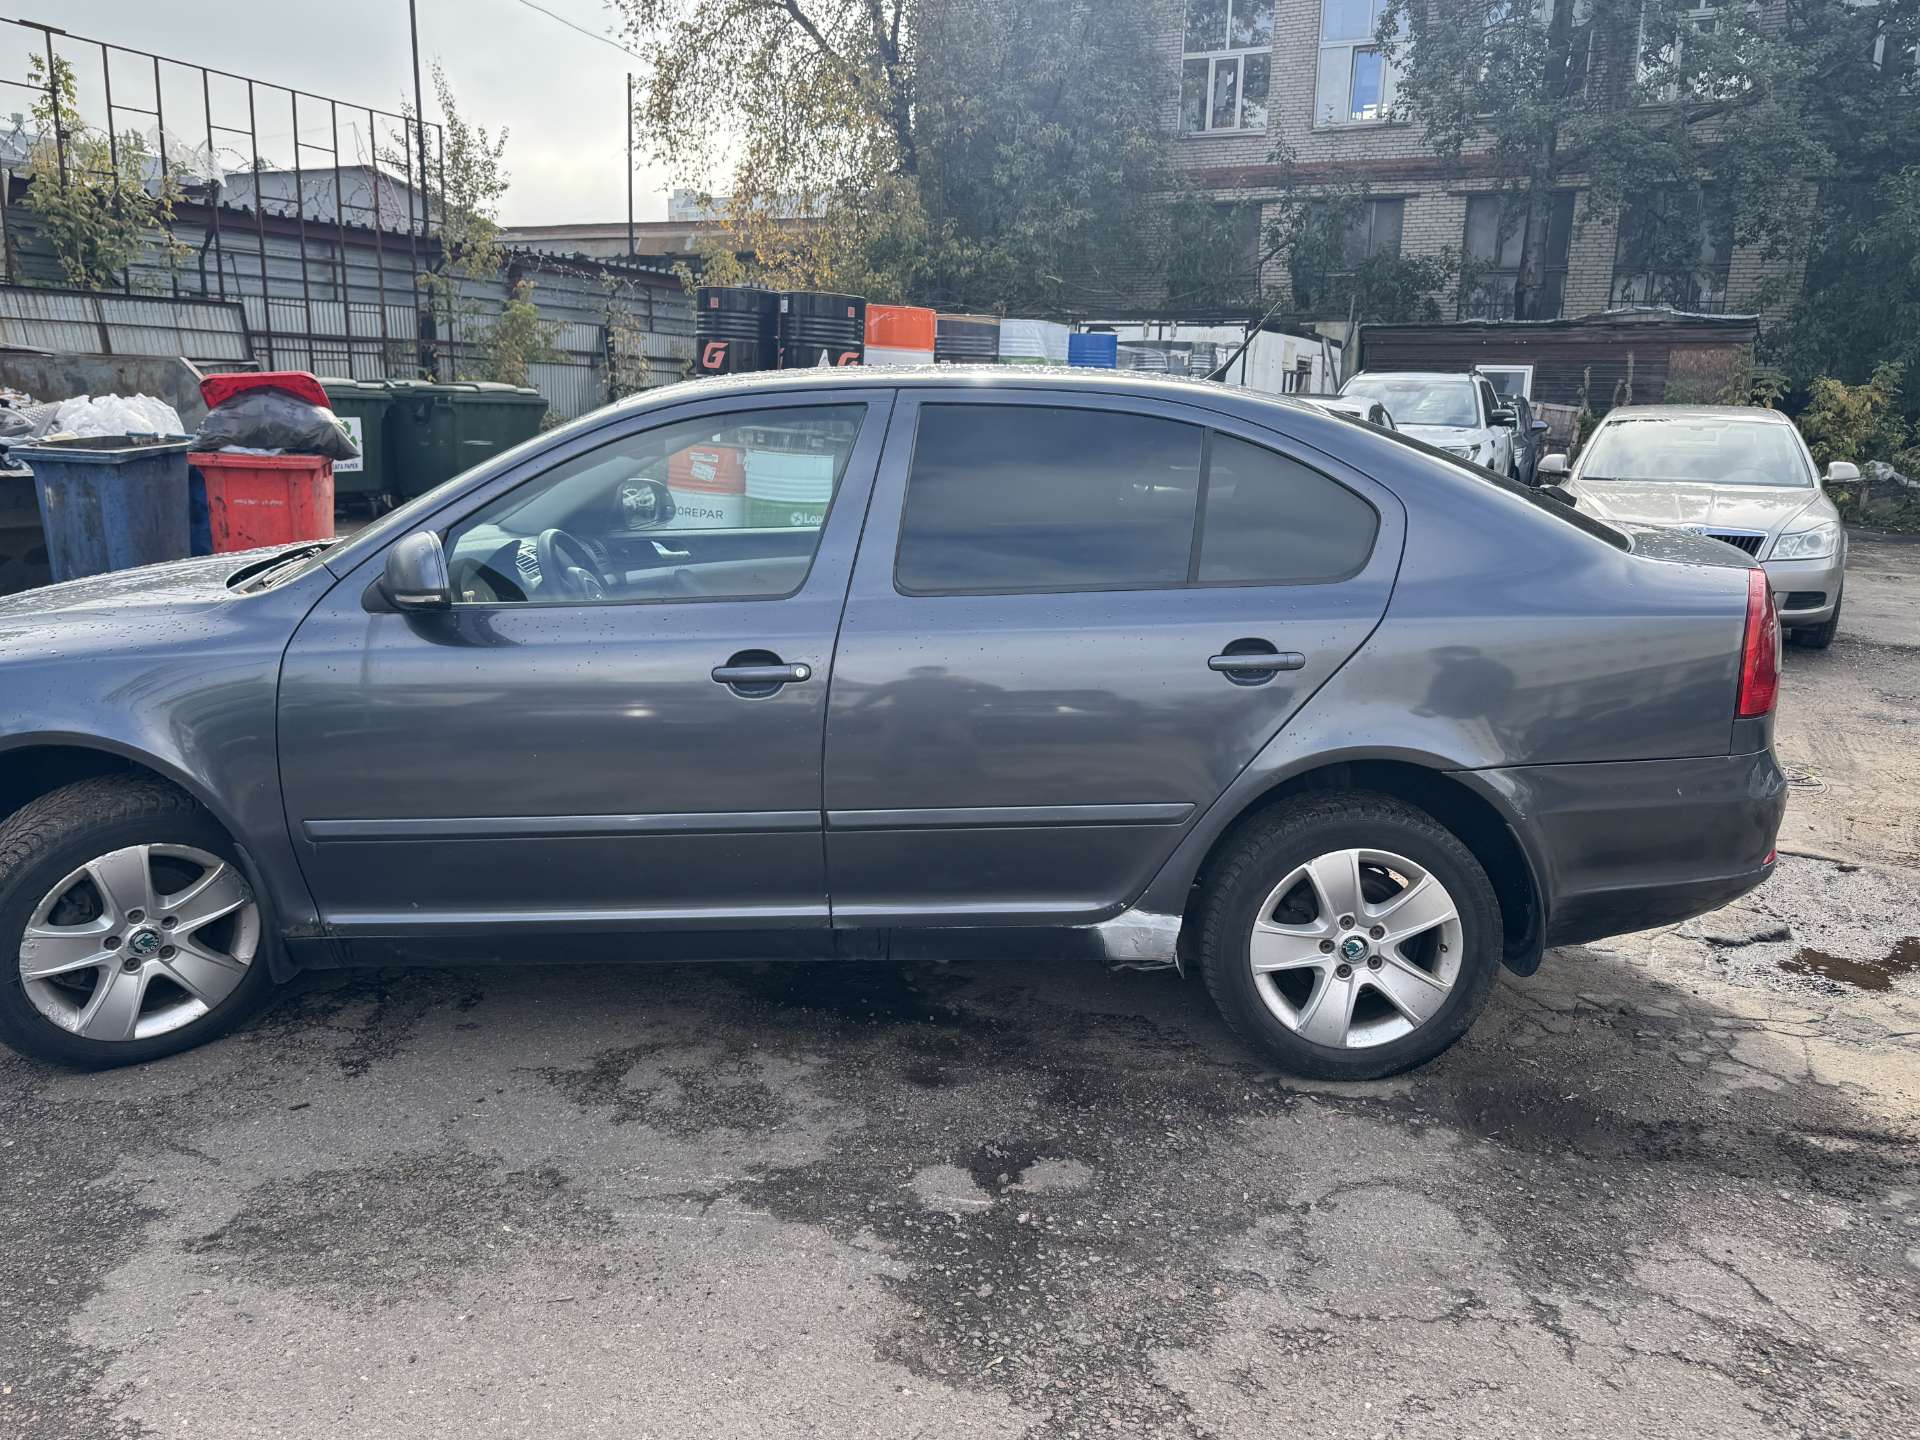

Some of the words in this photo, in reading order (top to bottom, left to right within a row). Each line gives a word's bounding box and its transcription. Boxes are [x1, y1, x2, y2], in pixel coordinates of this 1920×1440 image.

[702, 342, 729, 369] G
[677, 506, 724, 519] OREPAR
[804, 512, 823, 526] Lop
